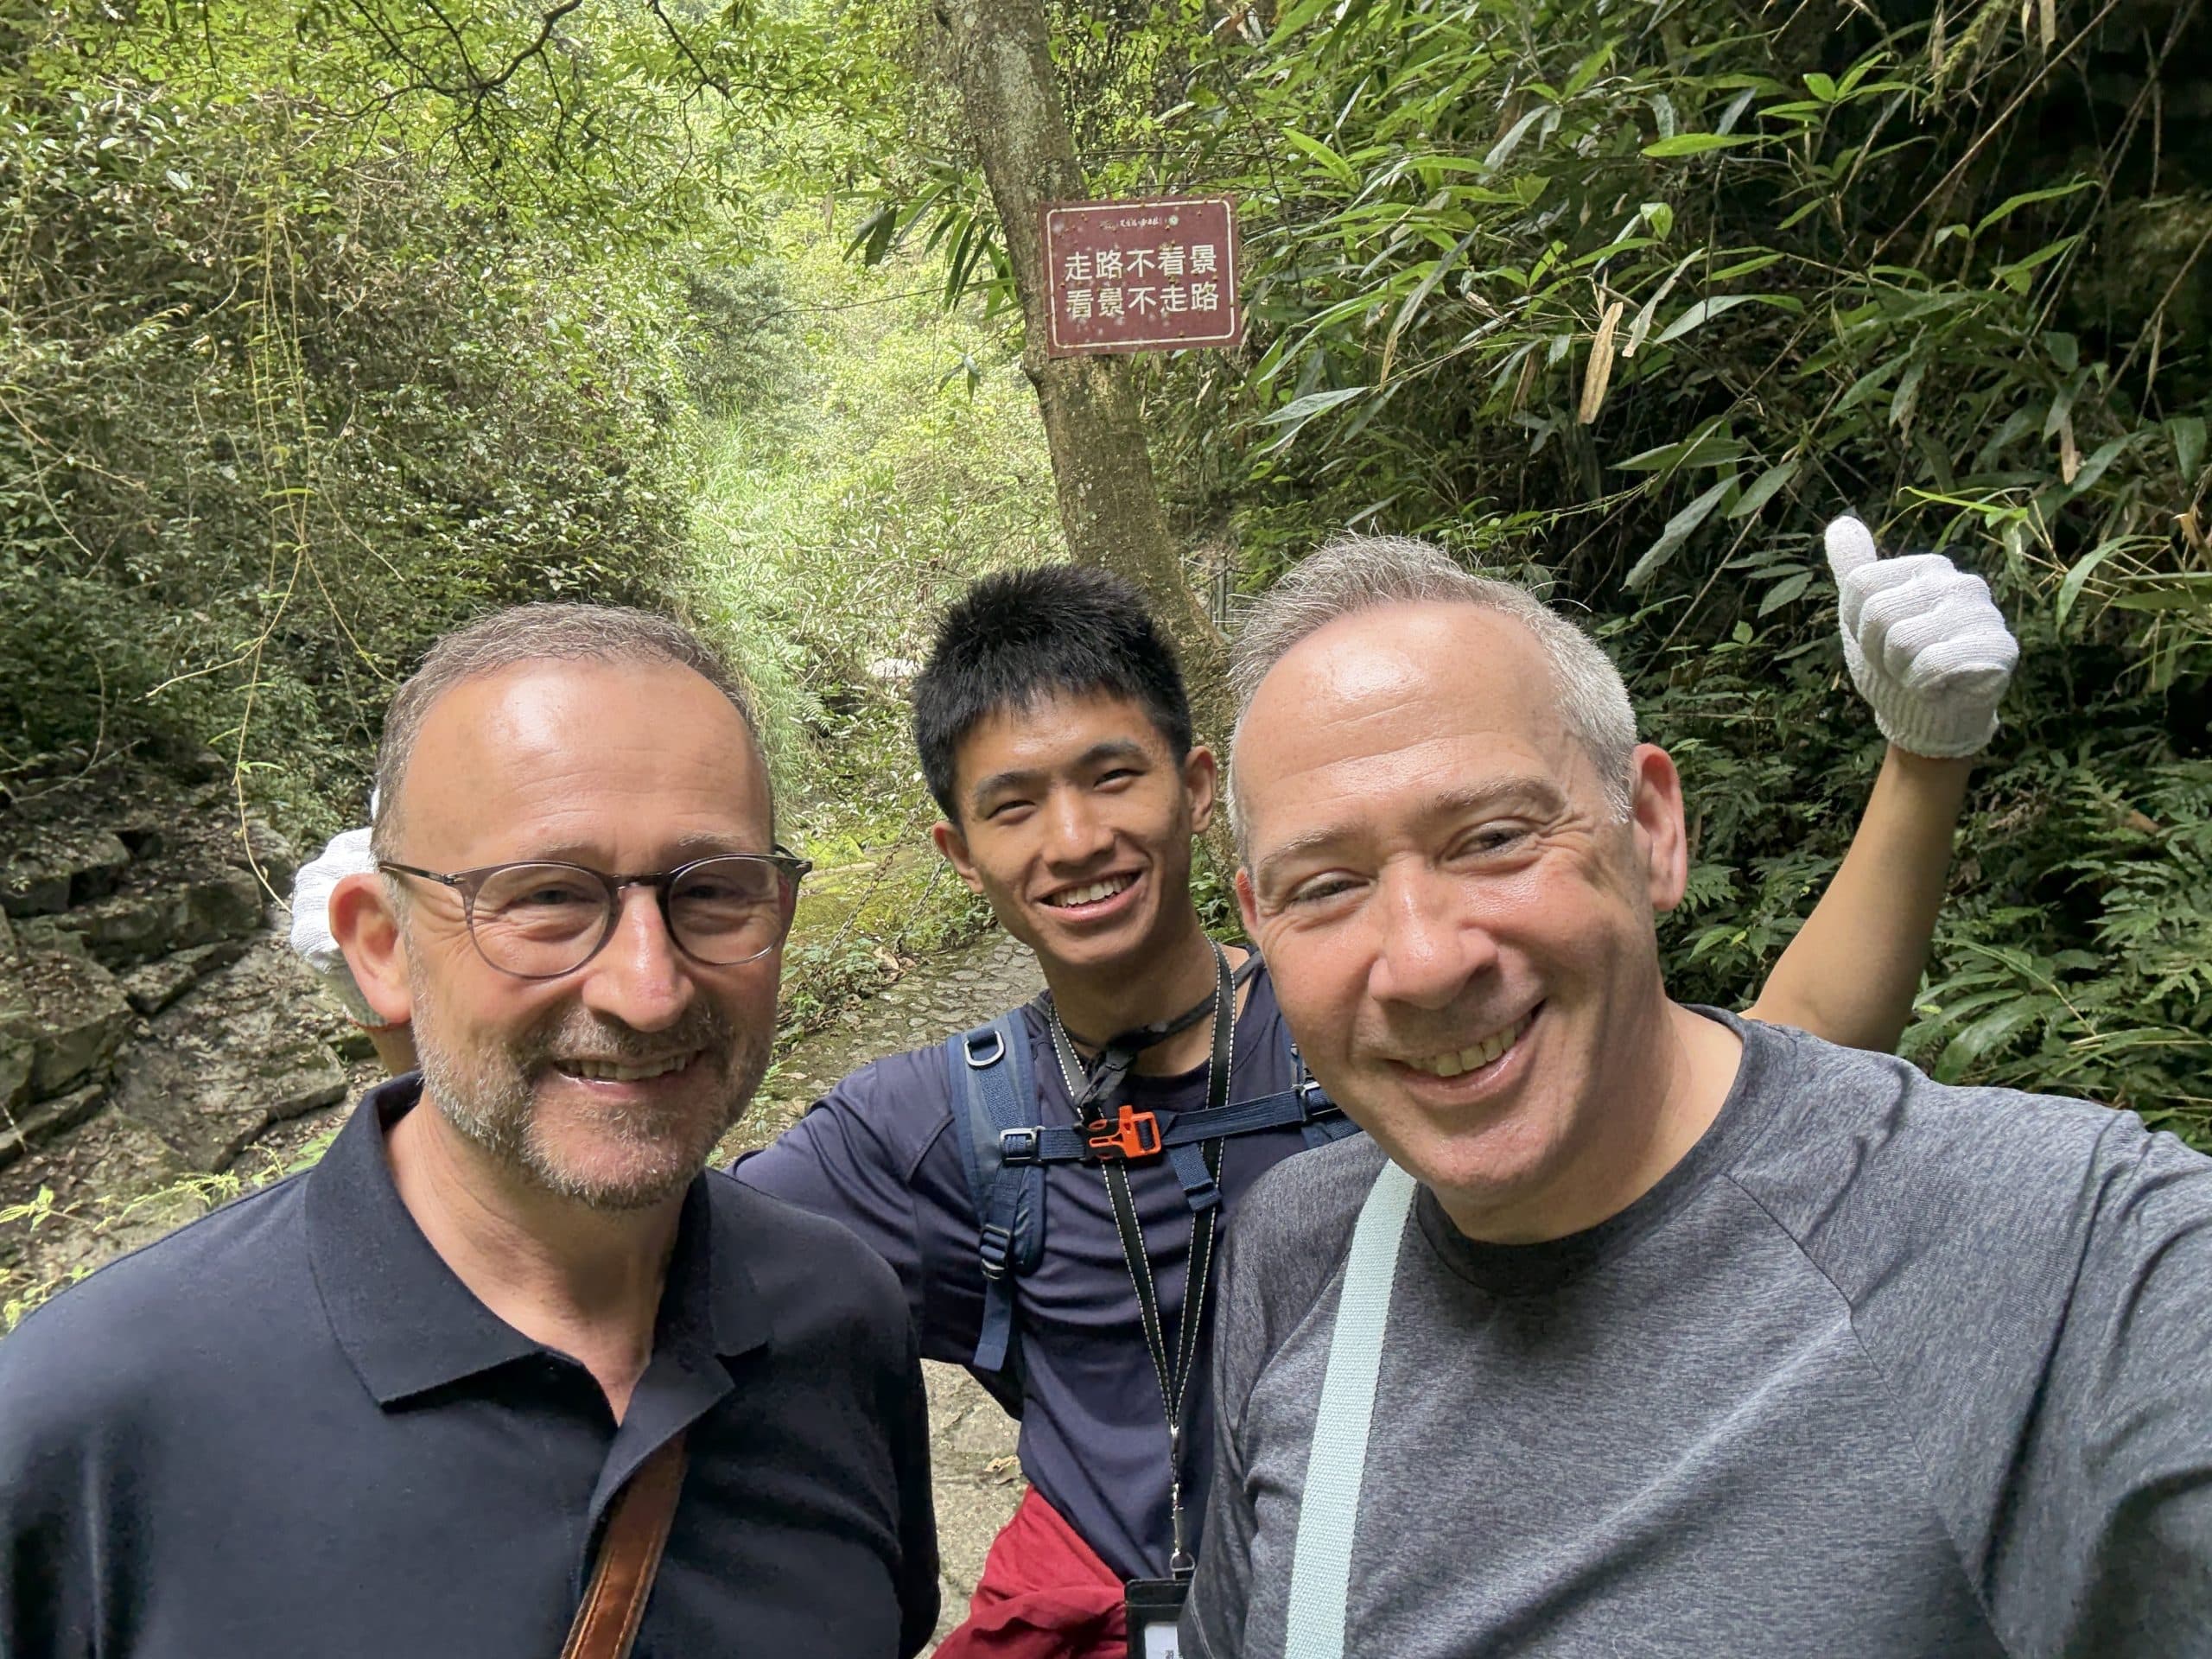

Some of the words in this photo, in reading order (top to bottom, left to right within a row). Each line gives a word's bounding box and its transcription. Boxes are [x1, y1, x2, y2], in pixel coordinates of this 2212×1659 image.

[1065, 245, 1217, 282] 走路不看景
[1065, 282, 1219, 320] 看景不走路
